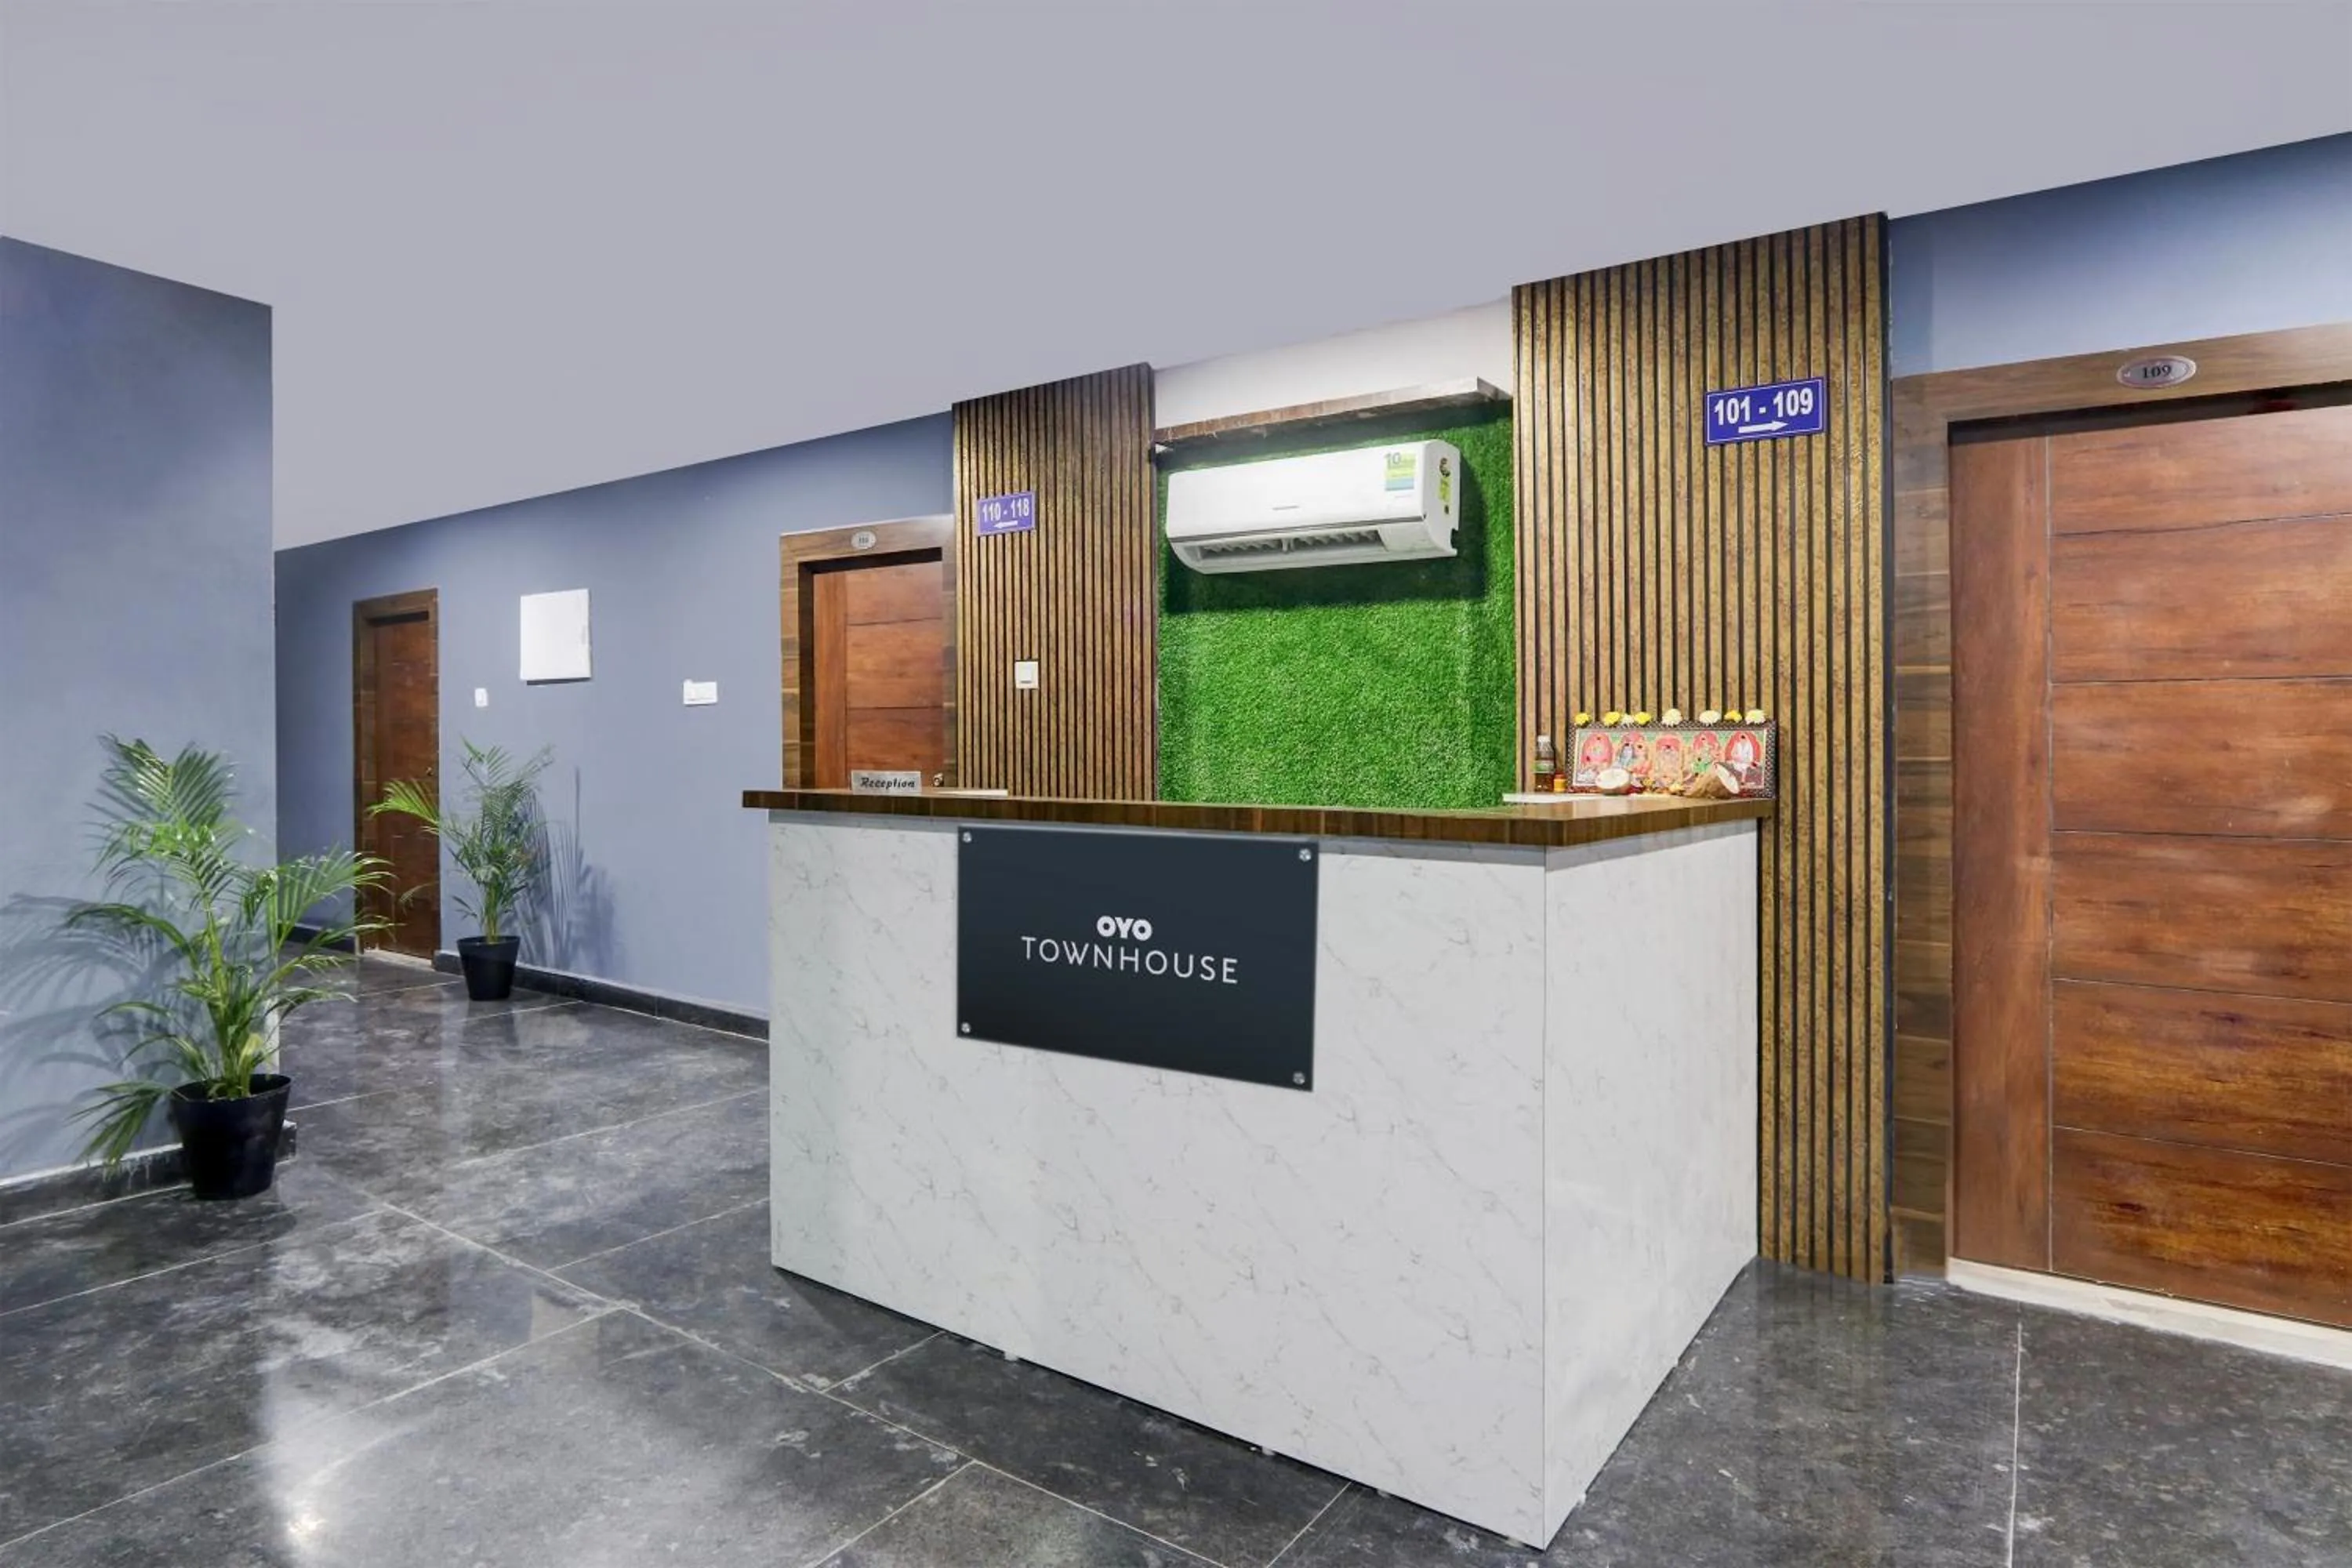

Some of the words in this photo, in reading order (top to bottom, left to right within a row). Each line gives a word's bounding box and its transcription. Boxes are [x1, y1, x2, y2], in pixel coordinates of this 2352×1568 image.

[2143, 365, 2172, 378] 109
[1714, 395, 1751, 426] 101
[1773, 387, 1813, 418] 109
[982, 502, 1001, 523] 110
[1010, 498, 1029, 518] 118
[860, 777, 915, 790] Reception
[1097, 916, 1152, 941] OYO
[1021, 936, 1239, 984] TOWNHOUSE
